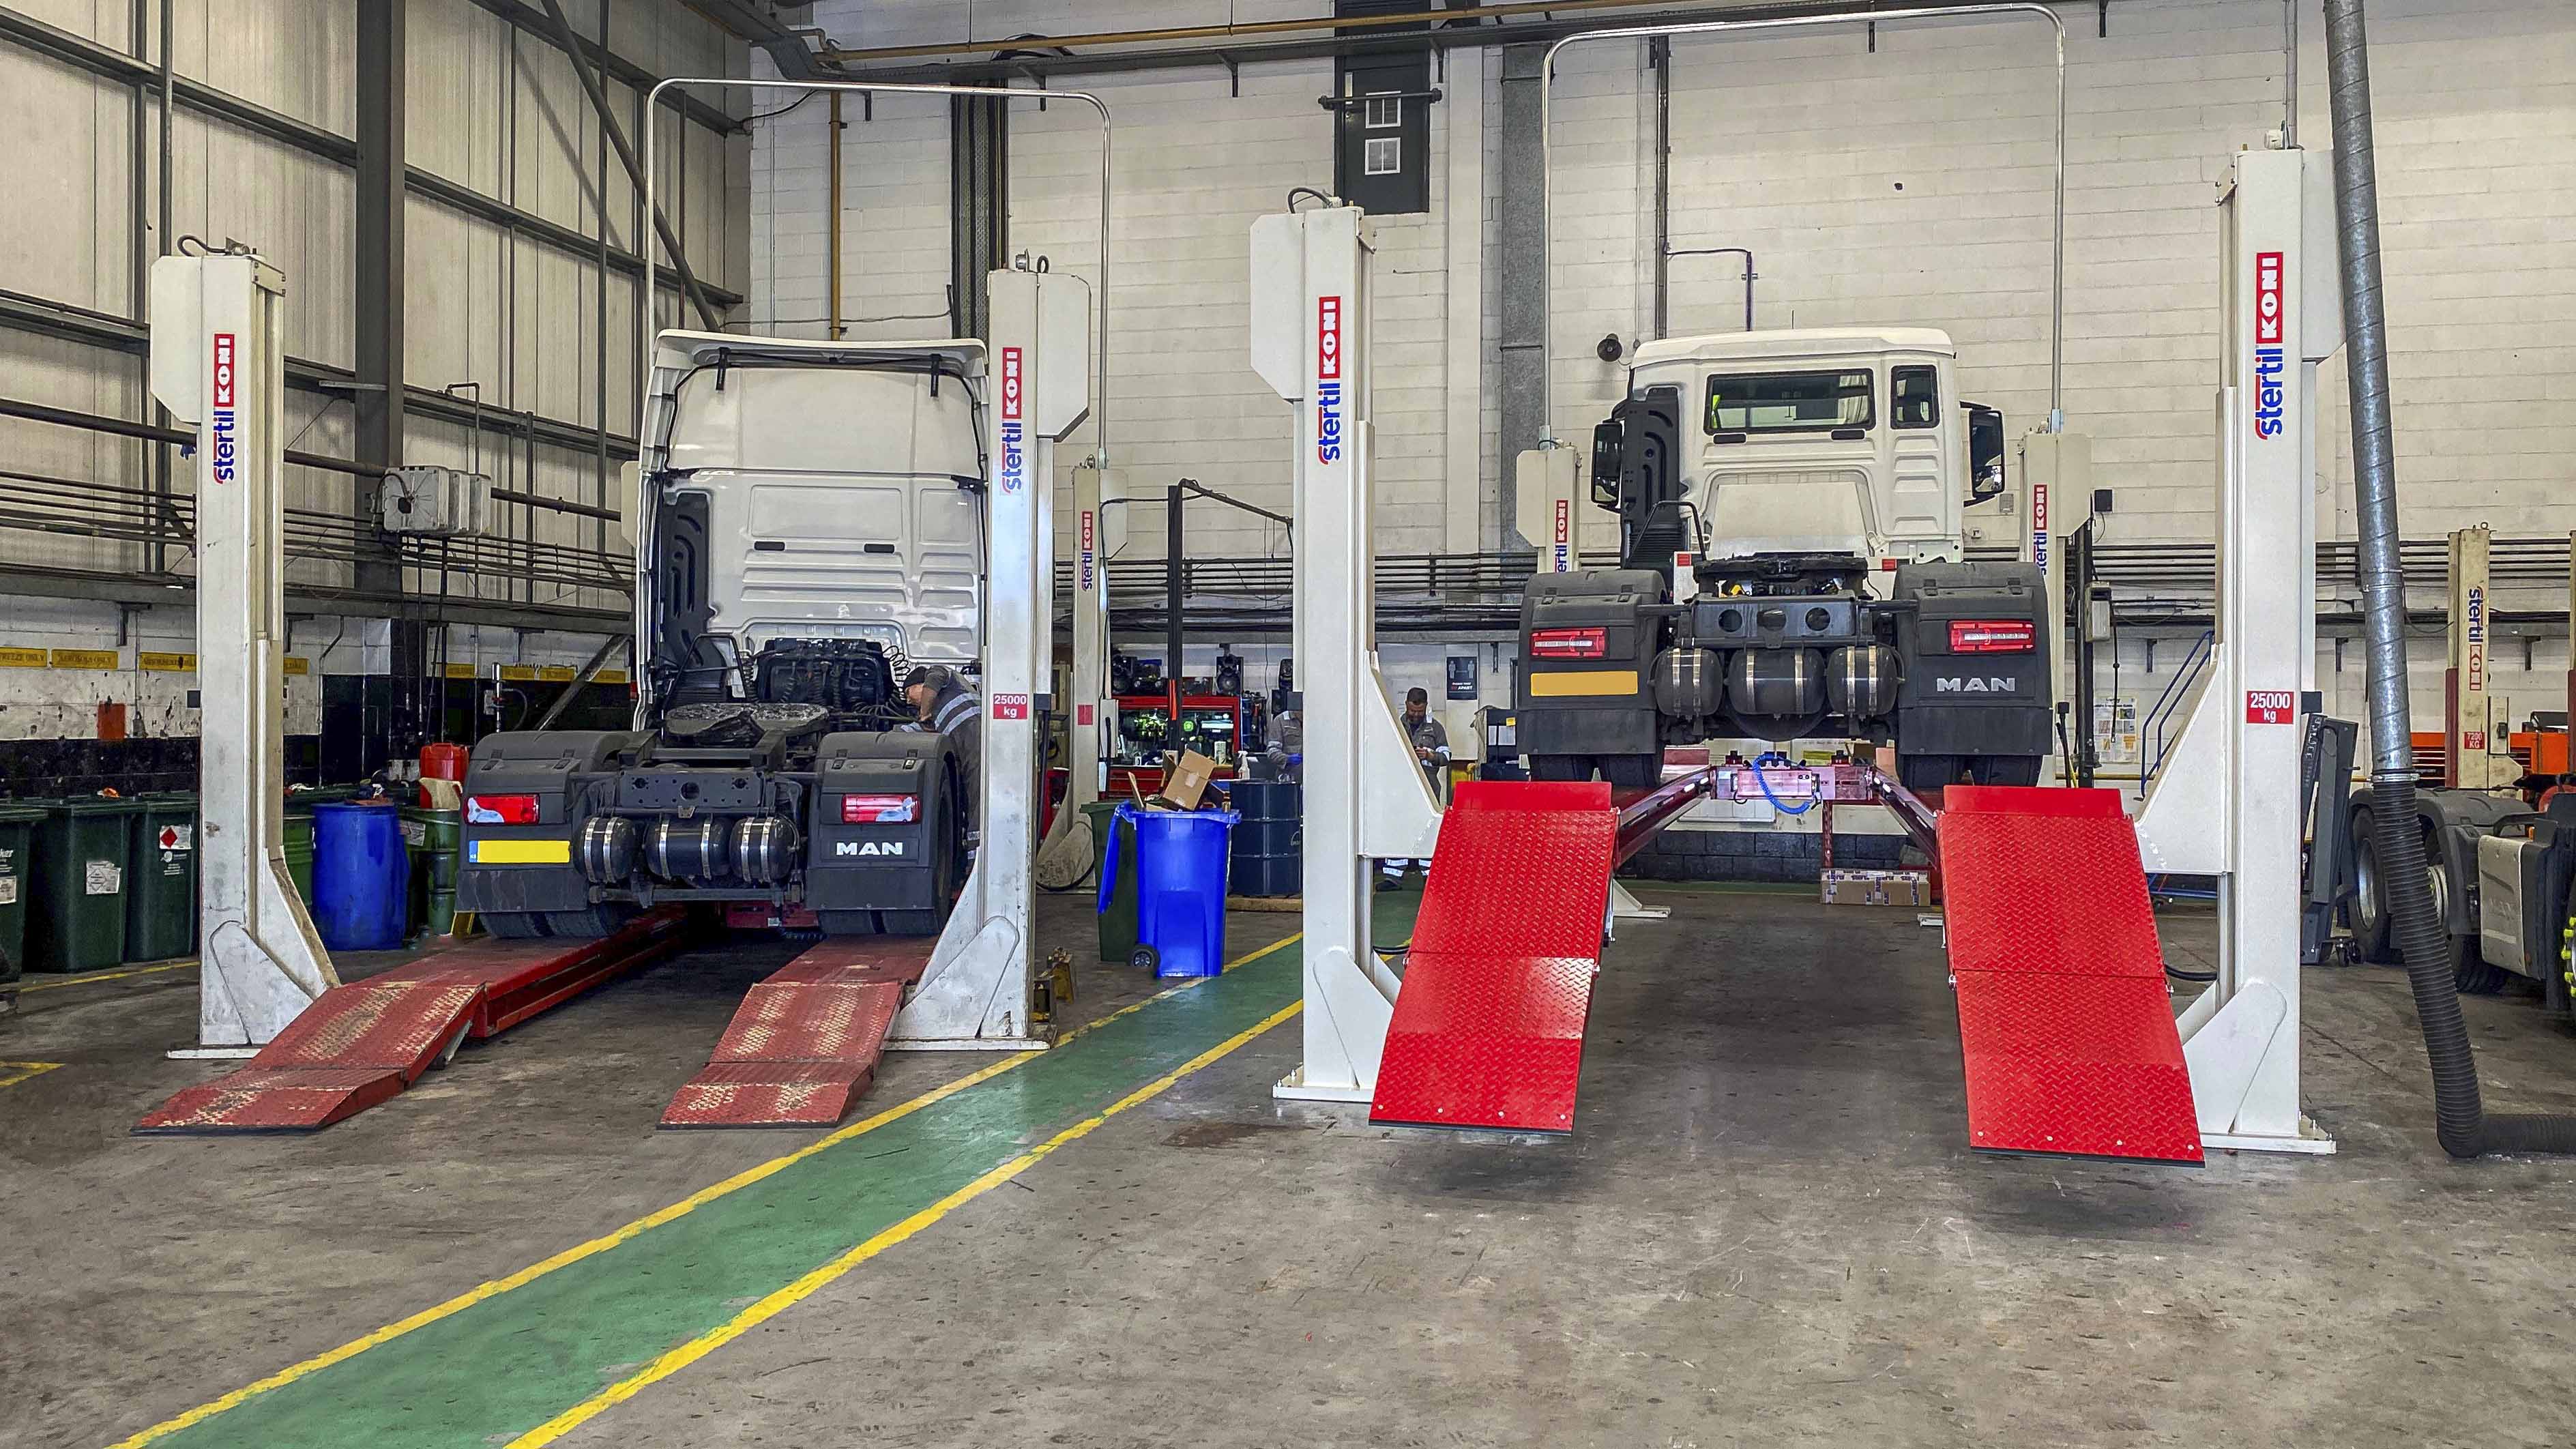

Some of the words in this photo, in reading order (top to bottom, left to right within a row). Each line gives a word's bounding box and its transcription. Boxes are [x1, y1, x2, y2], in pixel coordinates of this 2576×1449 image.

[2259, 256, 2279, 340] KONI
[1321, 299, 1337, 376] KONI
[217, 336, 231, 404] KONI
[1005, 350, 1019, 416] KONI
[2255, 349, 2283, 440] stertil
[1318, 383, 1341, 465] stertil
[213, 411, 234, 484] stertil
[1002, 422, 1022, 494] stertil
[1557, 501, 1566, 542] KONI
[2036, 486, 2045, 529] KONI
[1083, 513, 1092, 549] KONI
[1081, 553, 1093, 591] stertil
[1555, 545, 1567, 572] ertil
[2469, 586, 2484, 643] stertil
[1937, 677, 2015, 692] MAN
[2470, 645, 2481, 690] KONI
[994, 695, 1027, 705] 25000
[1004, 706, 1017, 718] kg
[2250, 692, 2291, 709] 25000
[2264, 708, 2277, 723] kg
[2470, 740, 2480, 748] KG
[836, 842, 903, 855] MAN
